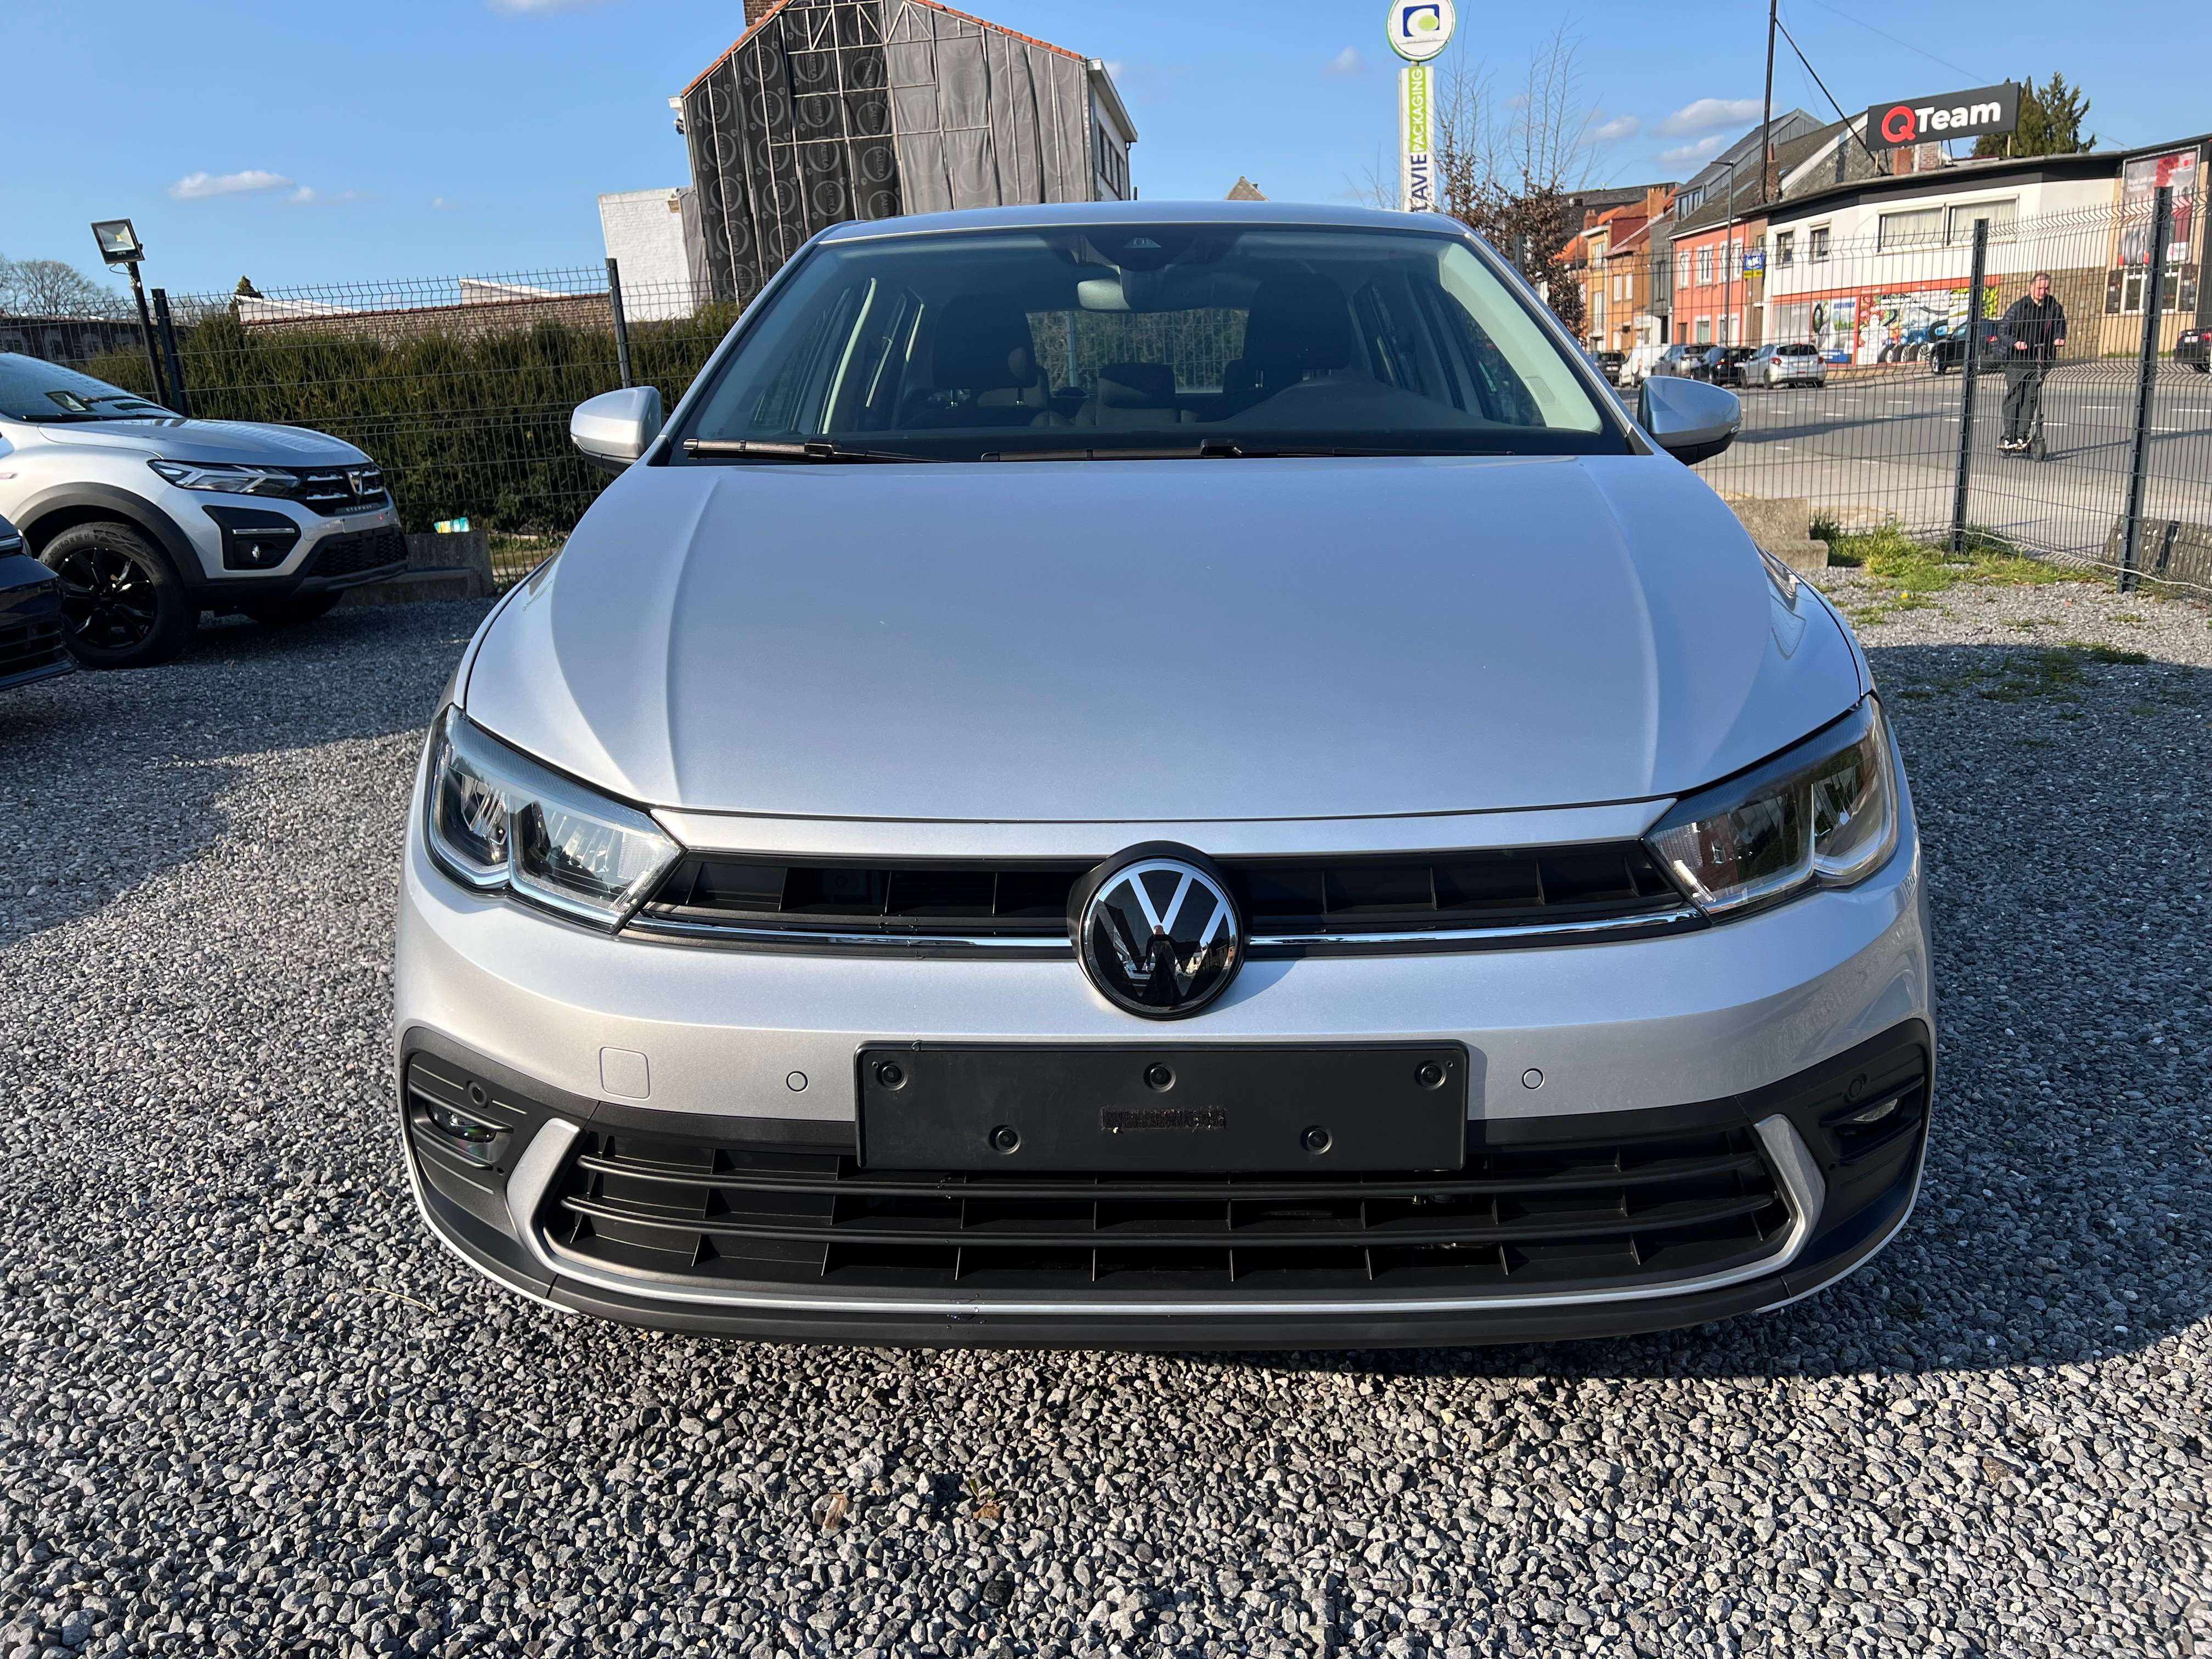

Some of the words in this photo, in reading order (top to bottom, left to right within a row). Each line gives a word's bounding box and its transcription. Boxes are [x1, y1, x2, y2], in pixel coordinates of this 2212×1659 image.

[1410, 68, 1424, 152] PACKAGING
[1881, 101, 2001, 143] QTeam
[1092, 862, 1232, 1001] VW
